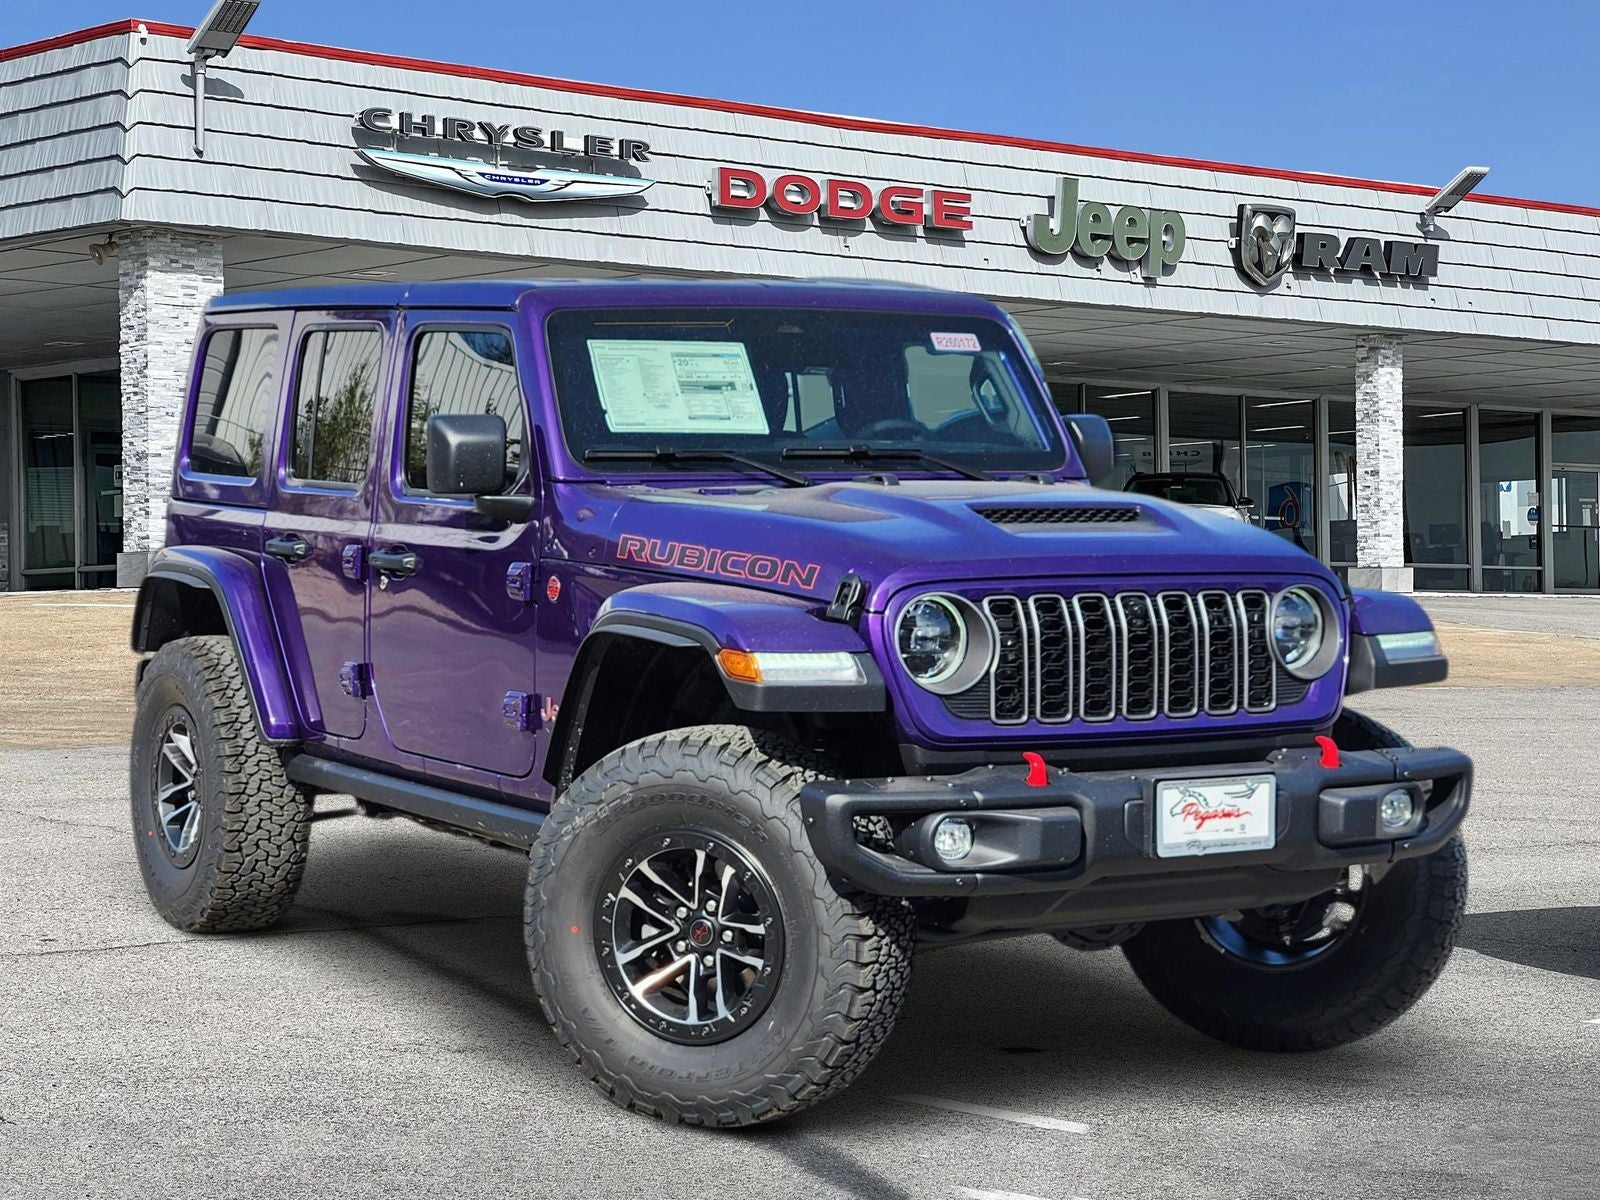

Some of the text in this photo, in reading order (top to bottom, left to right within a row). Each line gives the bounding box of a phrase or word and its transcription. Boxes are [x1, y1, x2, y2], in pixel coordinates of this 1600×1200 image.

[359, 107, 651, 162] CHRYSLER
[484, 174, 541, 185] CHRYSLER
[711, 166, 974, 231] DODGE
[1026, 176, 1187, 279] Jeep
[1298, 231, 1440, 277] RAM
[616, 533, 821, 590] RUBICON
[1181, 802, 1253, 830] Pegasus
